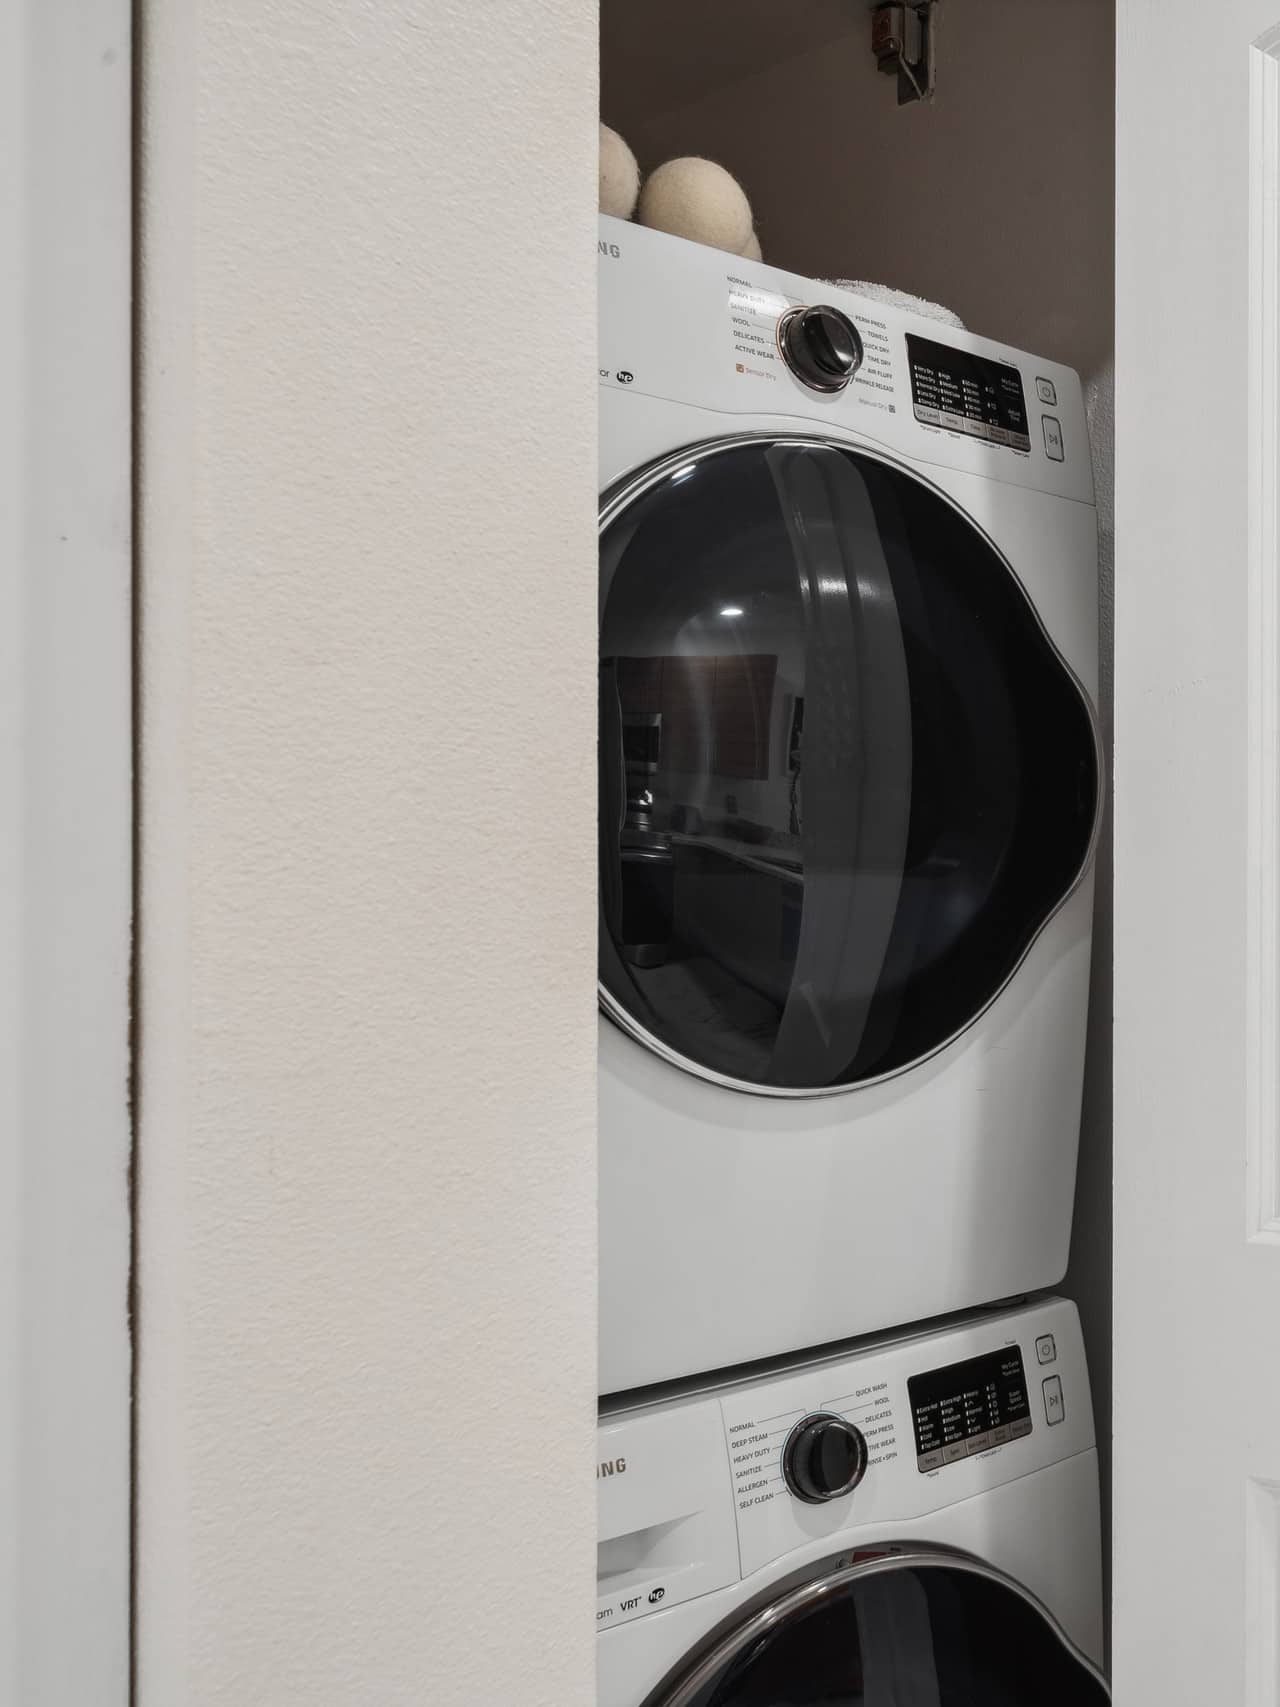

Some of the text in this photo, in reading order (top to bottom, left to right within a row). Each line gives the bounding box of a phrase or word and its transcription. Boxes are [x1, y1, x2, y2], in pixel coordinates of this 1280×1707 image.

[727, 276, 752, 288] NORMAL
[732, 317, 750, 327] WOOL
[733, 330, 764, 344] DELICATES
[735, 344, 775, 360] ACTIVE WEAR
[856, 1388, 872, 1397] QUICK
[865, 1410, 892, 1423] DELICATES
[730, 1422, 755, 1433] NORMAL
[732, 1433, 768, 1448] DEEP STEAM
[734, 1448, 770, 1464] HEAVY DUTY
[736, 1465, 762, 1479] SANITIZE
[738, 1480, 768, 1493] ALLERGEN
[739, 1493, 774, 1509] SELF CLEAN
